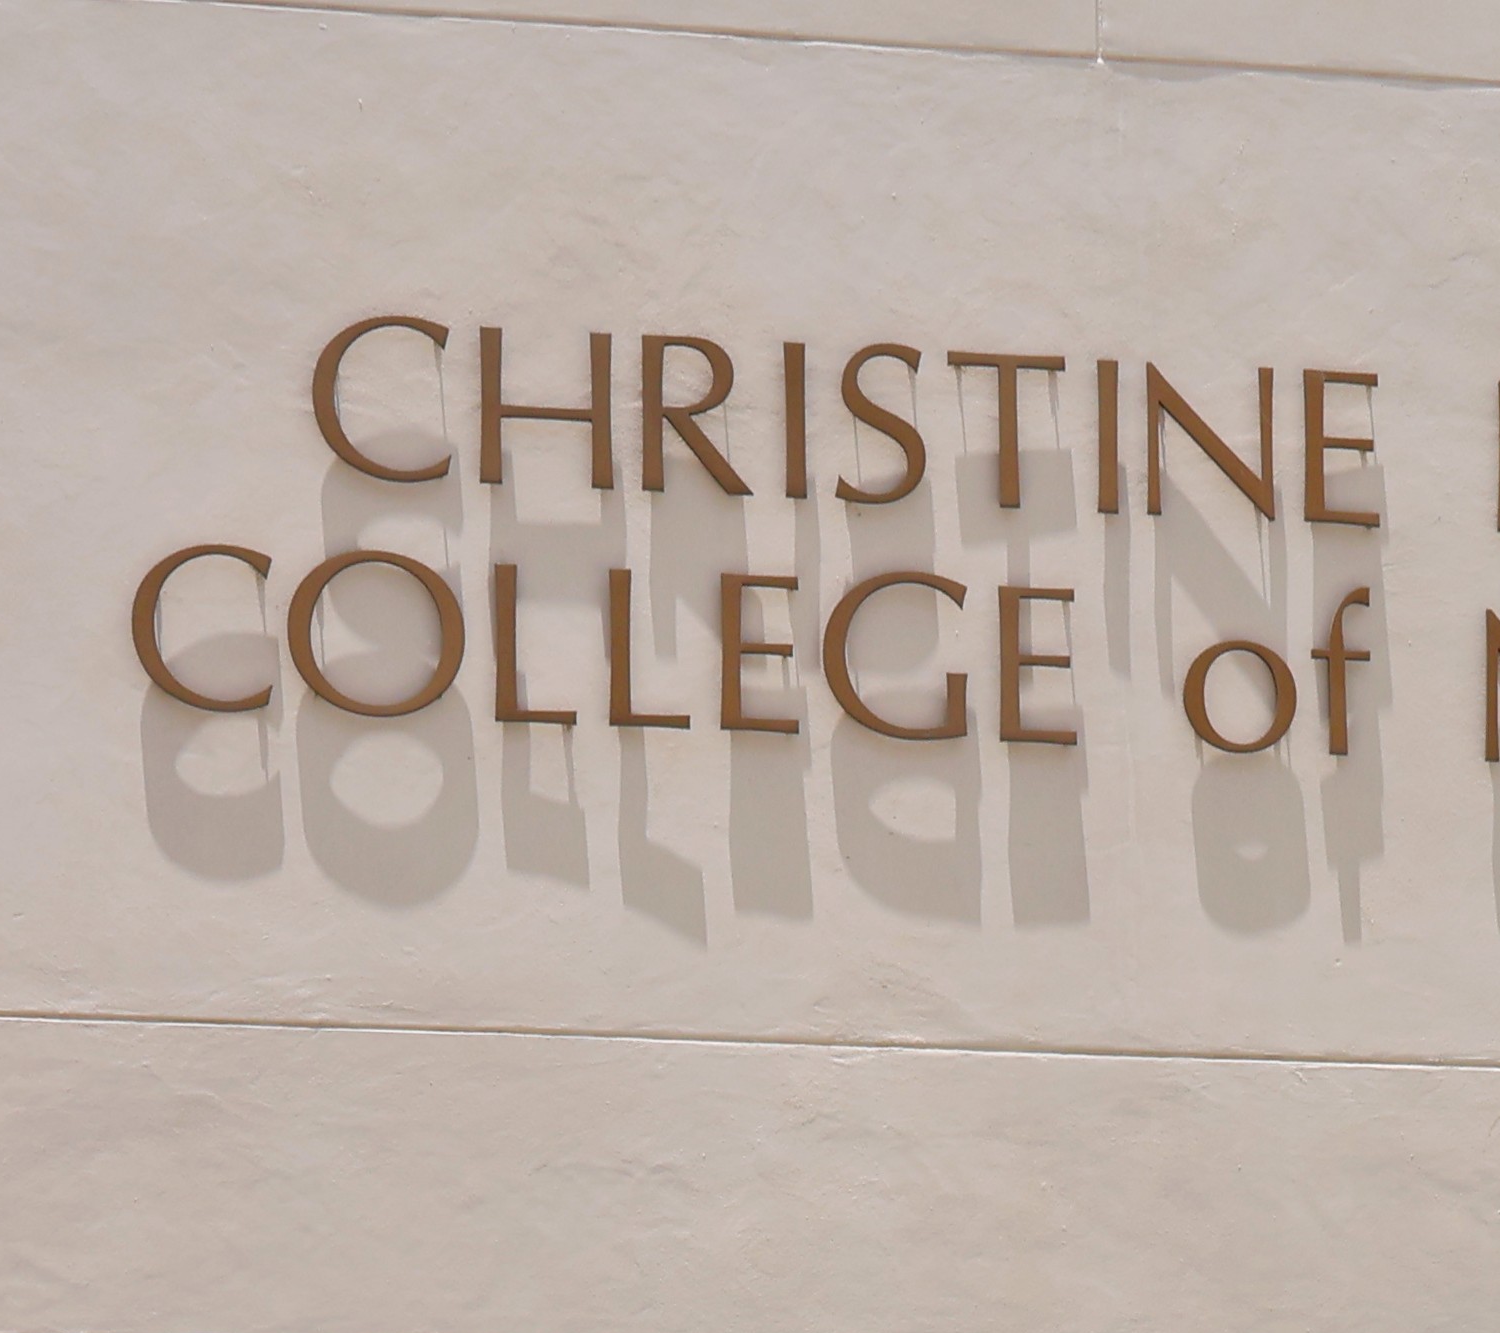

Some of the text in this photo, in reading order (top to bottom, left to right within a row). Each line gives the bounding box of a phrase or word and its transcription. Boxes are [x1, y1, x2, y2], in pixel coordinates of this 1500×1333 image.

[310, 316, 1384, 529] CHRISTINE
[130, 541, 1081, 747] COLLEGE
[1182, 584, 1375, 758] of
